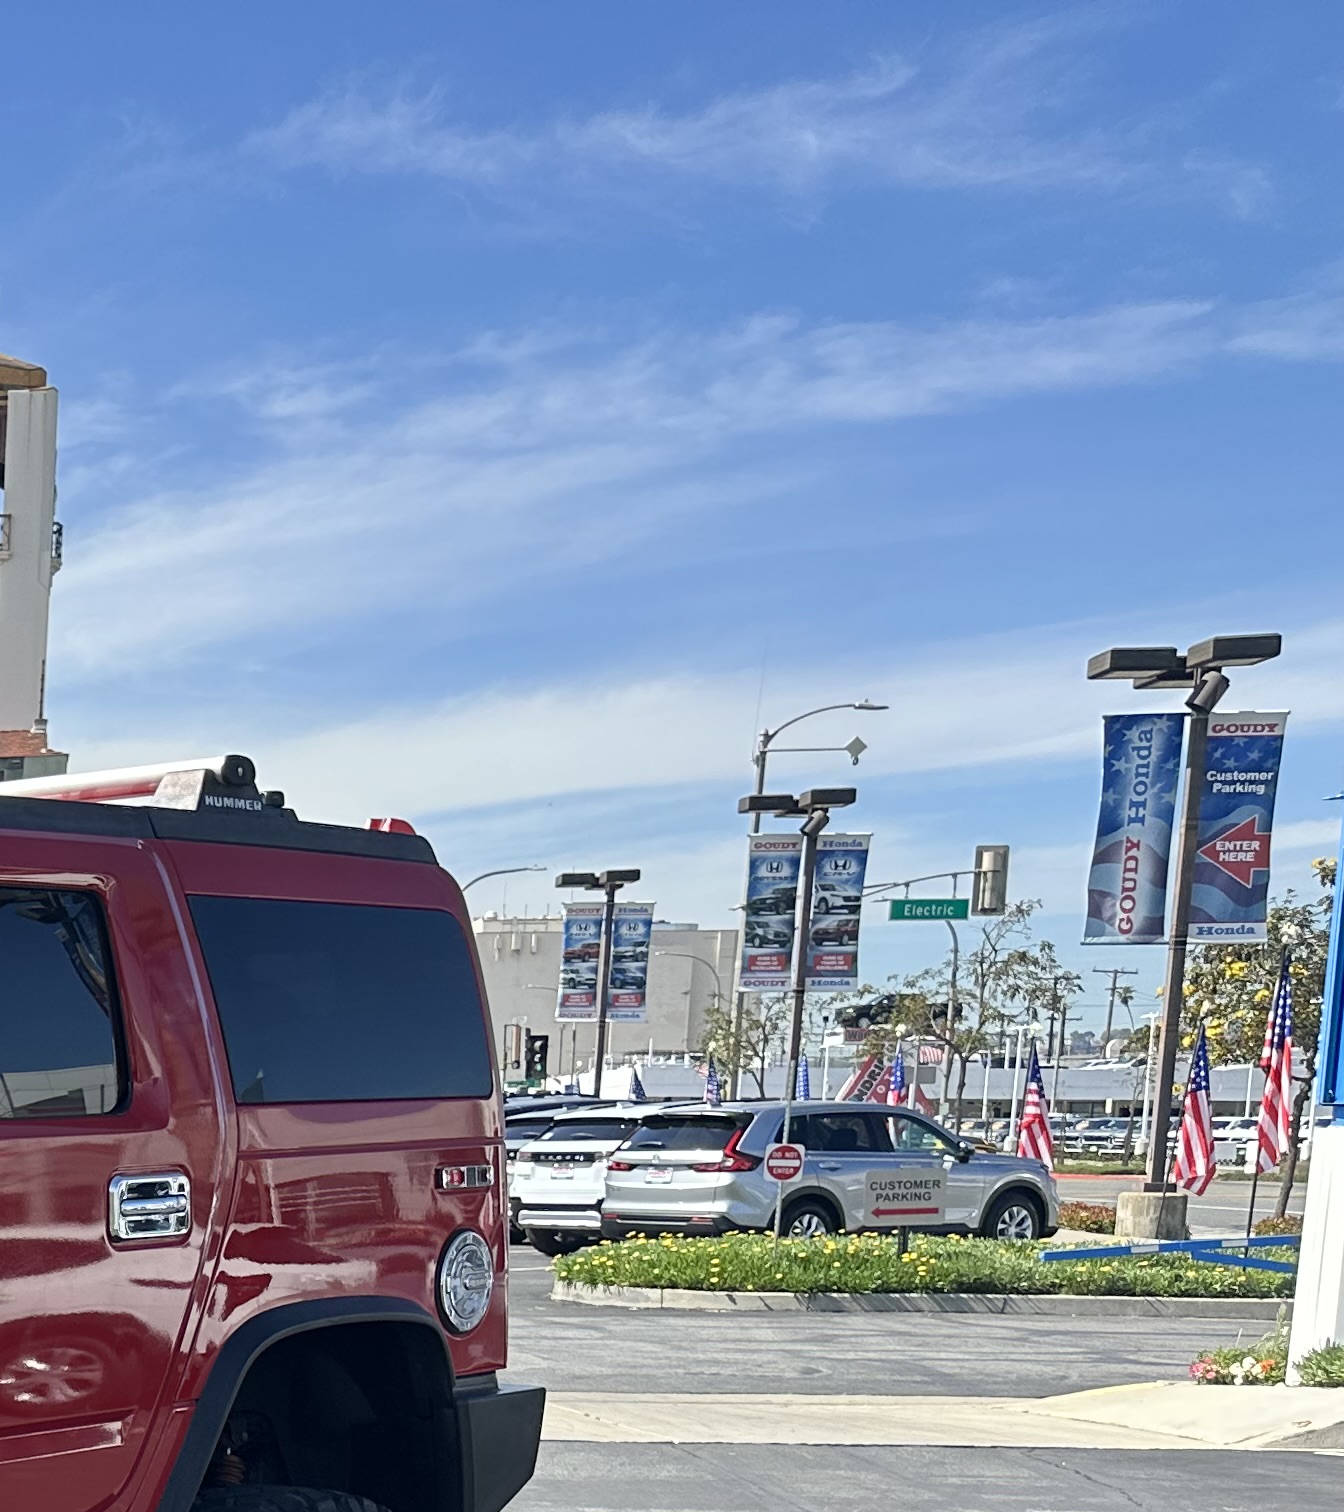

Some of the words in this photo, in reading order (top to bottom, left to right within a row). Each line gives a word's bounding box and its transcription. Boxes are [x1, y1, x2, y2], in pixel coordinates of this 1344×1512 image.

[1212, 723, 1279, 733] GOUDY
[1126, 727, 1154, 826] Honda
[1206, 770, 1275, 781] Customer
[1212, 782, 1266, 795] Parking
[205, 795, 262, 811] HUMMER
[822, 839, 863, 848] Honda
[1216, 841, 1260, 851] ENTER
[1219, 852, 1255, 862] HERE
[1117, 836, 1142, 935] GOUDY
[904, 904, 954, 916] Electric
[1196, 925, 1256, 936] Honda
[870, 1179, 941, 1191] CUSTOMER
[875, 1191, 932, 1202] PARKING
